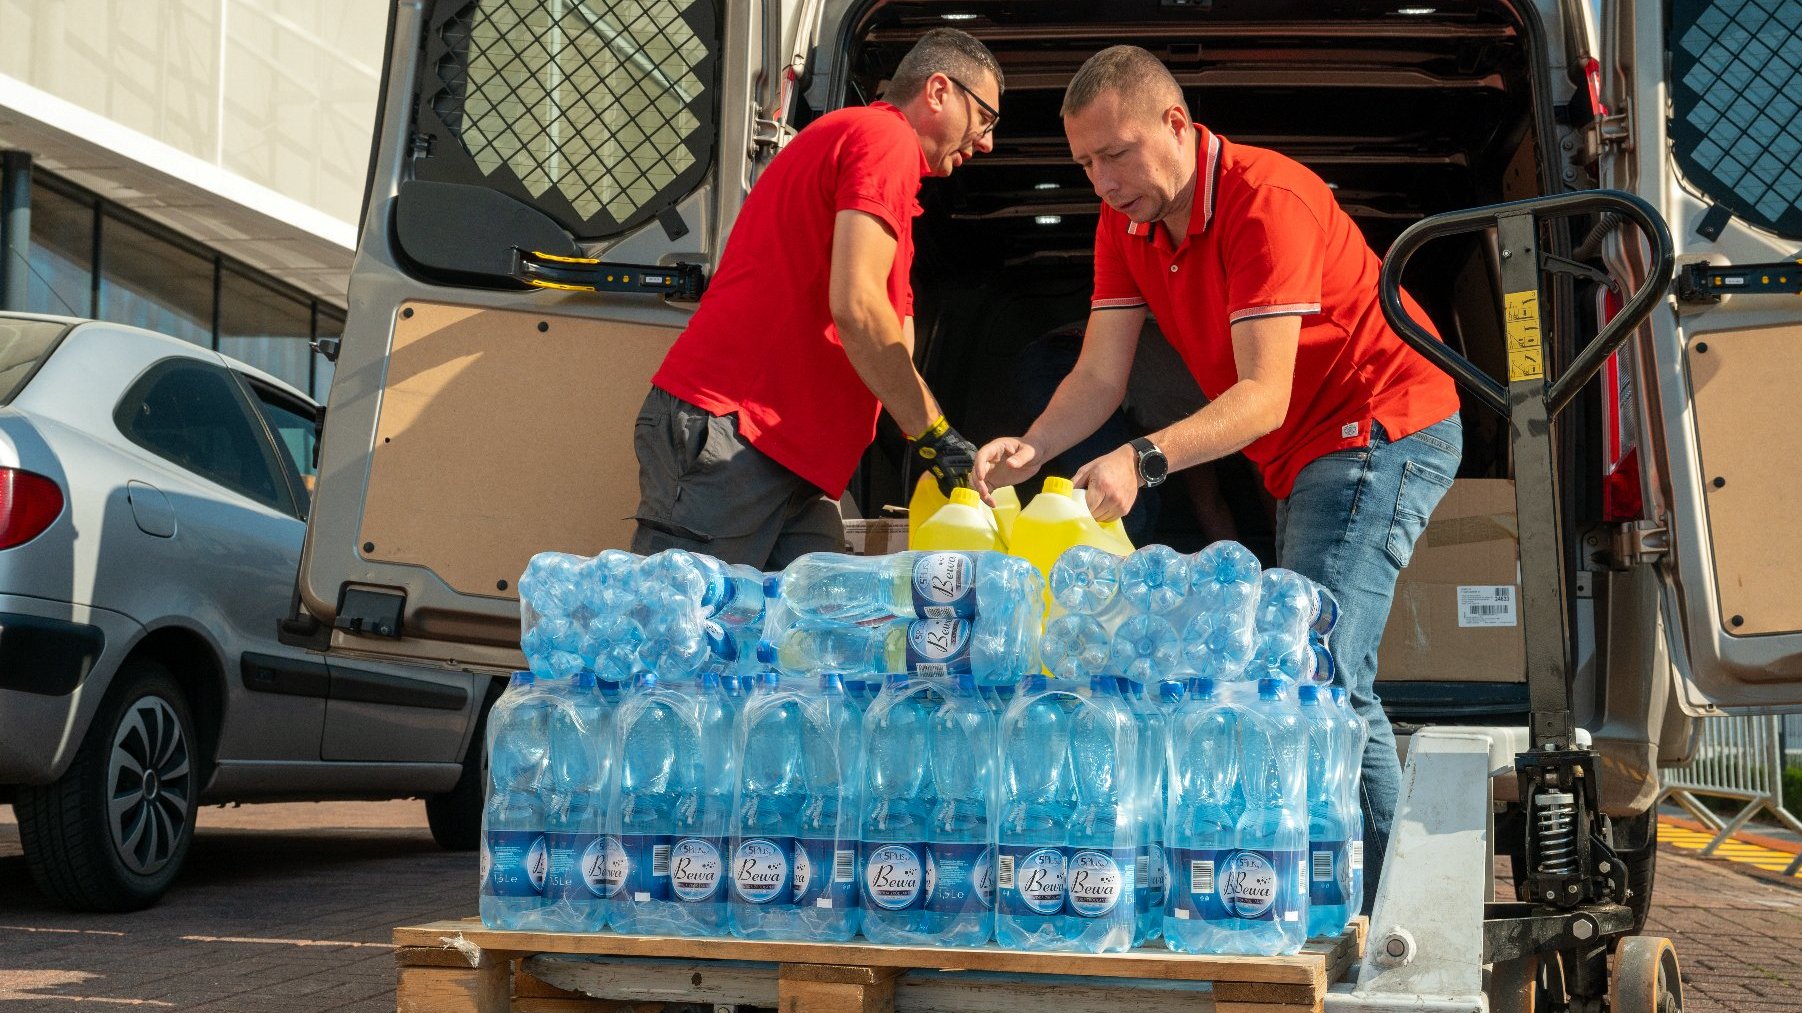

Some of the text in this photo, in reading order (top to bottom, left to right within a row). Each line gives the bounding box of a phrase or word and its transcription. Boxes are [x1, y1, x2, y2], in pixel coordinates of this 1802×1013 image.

[932, 556, 956, 597] Bewa
[673, 857, 715, 881] Bewa
[738, 858, 780, 882] Bewa
[872, 864, 916, 888] Bewa
[1071, 870, 1114, 895] Bewa
[1235, 871, 1271, 897] Bewa
